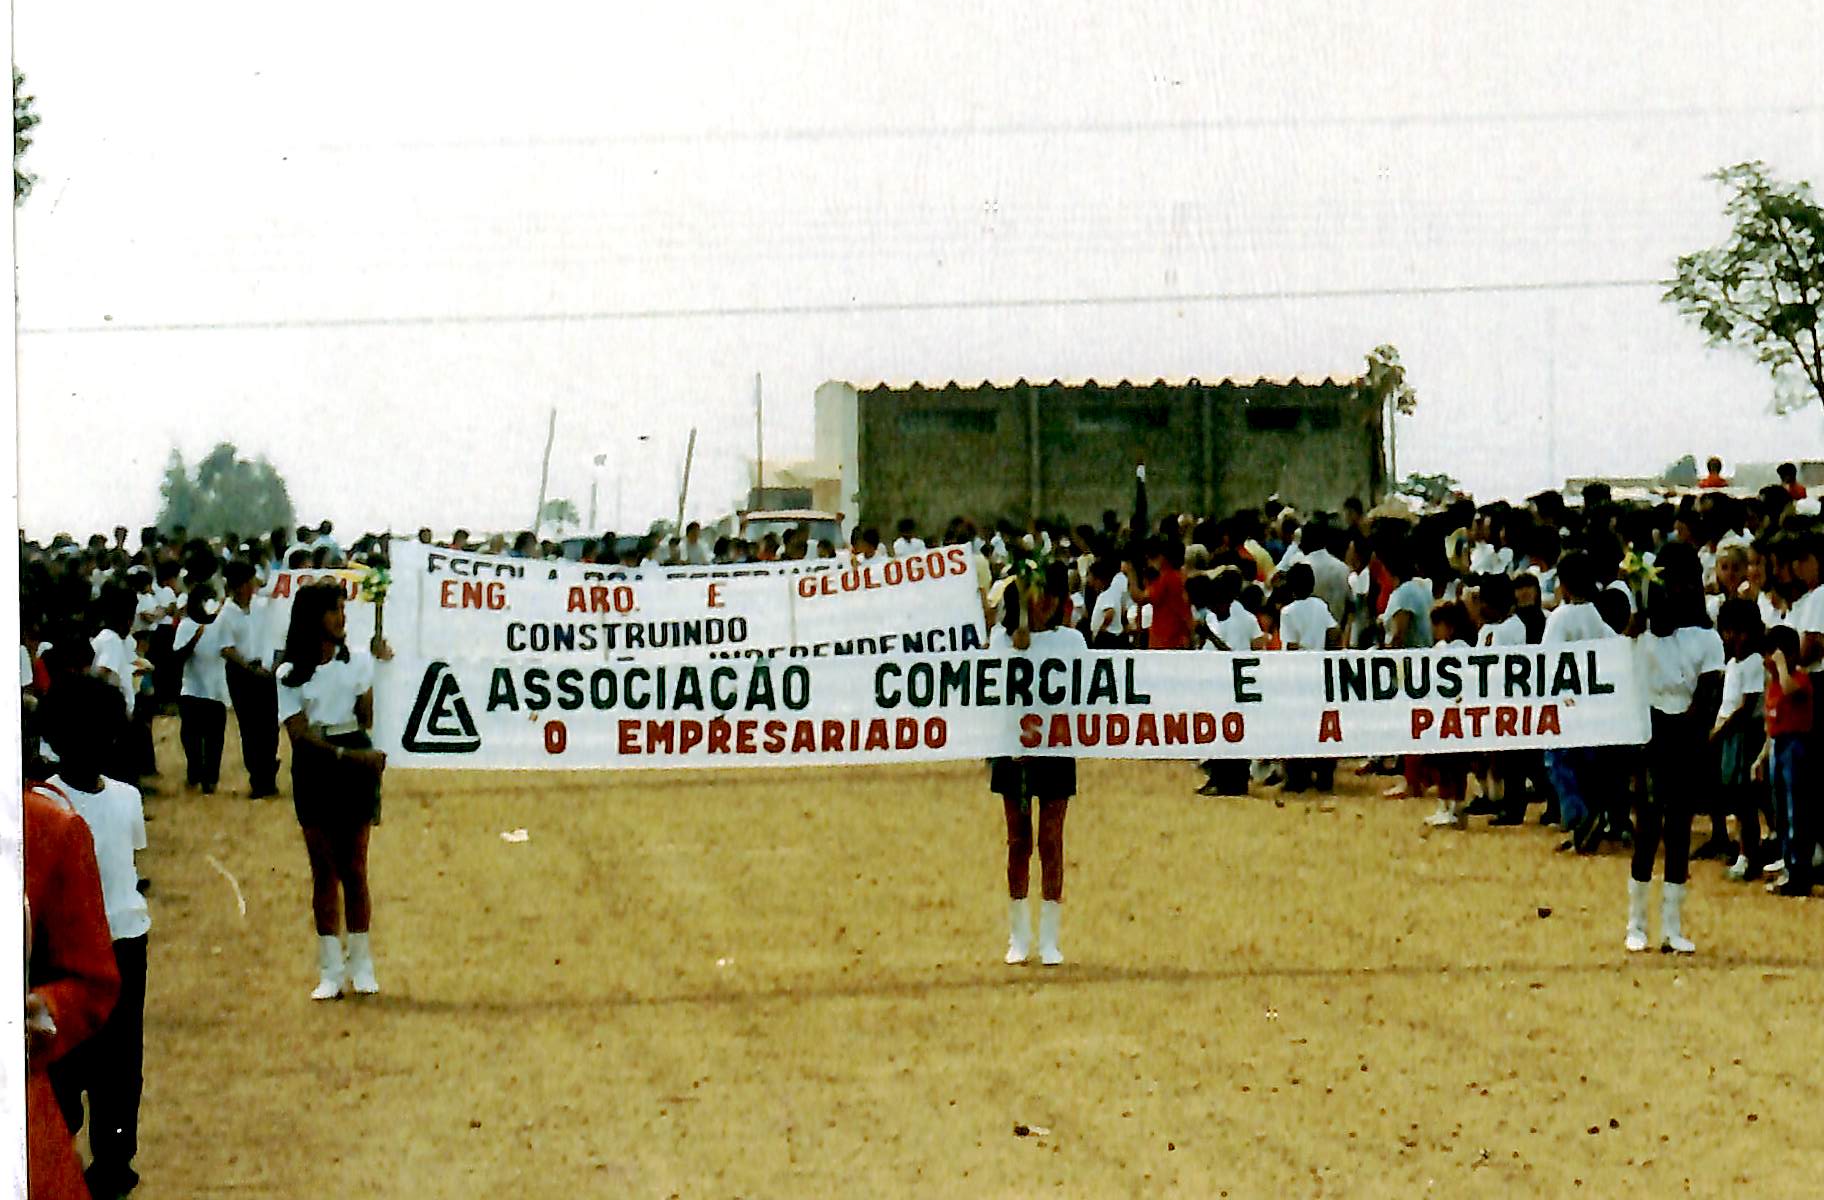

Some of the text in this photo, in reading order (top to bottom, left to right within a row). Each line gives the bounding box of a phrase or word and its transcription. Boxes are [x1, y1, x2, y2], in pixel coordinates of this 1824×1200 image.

[440, 580, 511, 610] ENG.
[708, 583, 726, 608] E
[507, 616, 748, 652] CONSTRUINDO
[875, 657, 1151, 708] COMERCIAL
[1233, 658, 1263, 703] E
[1324, 650, 1615, 702] INDUSTRIAL
[618, 717, 948, 755] EMPRESARIADO
[1019, 711, 1245, 749] SAUDANDO
[1318, 709, 1343, 743] A
